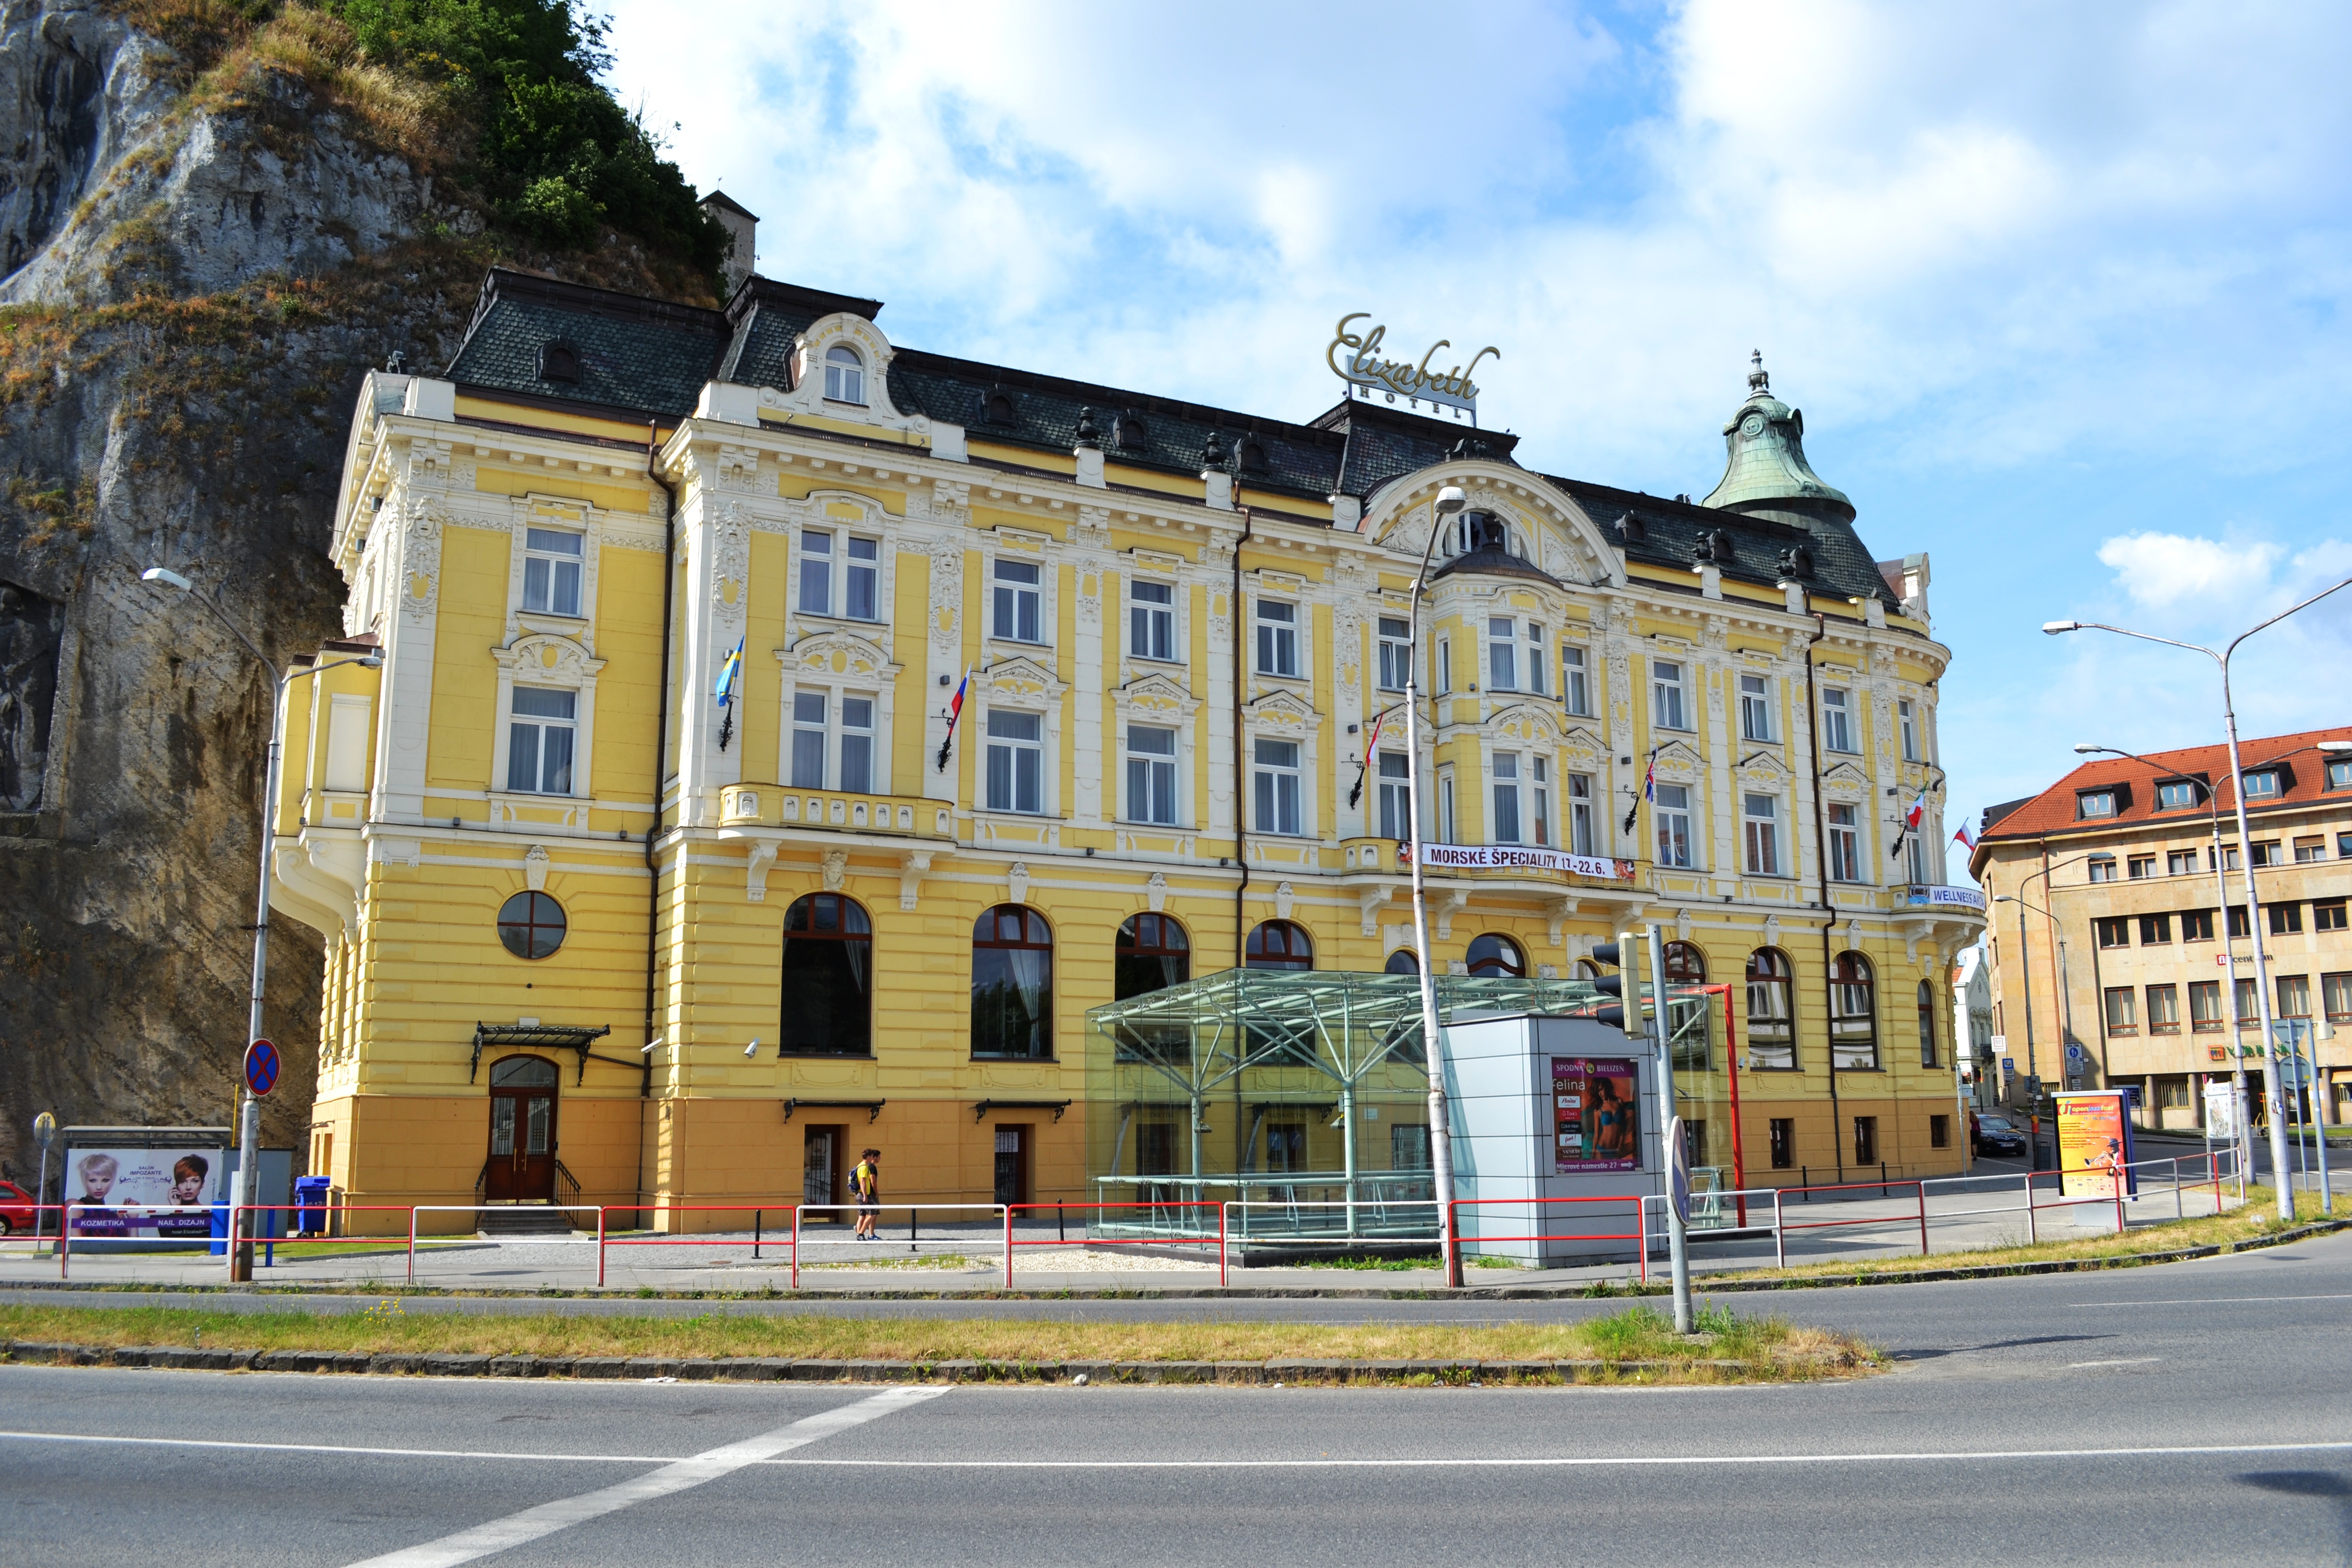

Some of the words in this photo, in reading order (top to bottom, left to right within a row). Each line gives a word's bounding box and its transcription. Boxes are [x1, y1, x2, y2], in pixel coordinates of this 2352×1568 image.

[1326, 312, 1501, 400] Elizabeth
[1359, 385, 1461, 419] HOTEL
[1431, 848, 1487, 864] MORSKÉ
[1491, 848, 1557, 868] ŠPECIALITY
[1933, 890, 1972, 903] WELLNESS
[2218, 954, 2273, 964] ficentm
[1597, 1064, 1624, 1072] BIELIZEŇ
[1552, 1079, 1585, 1090] felina
